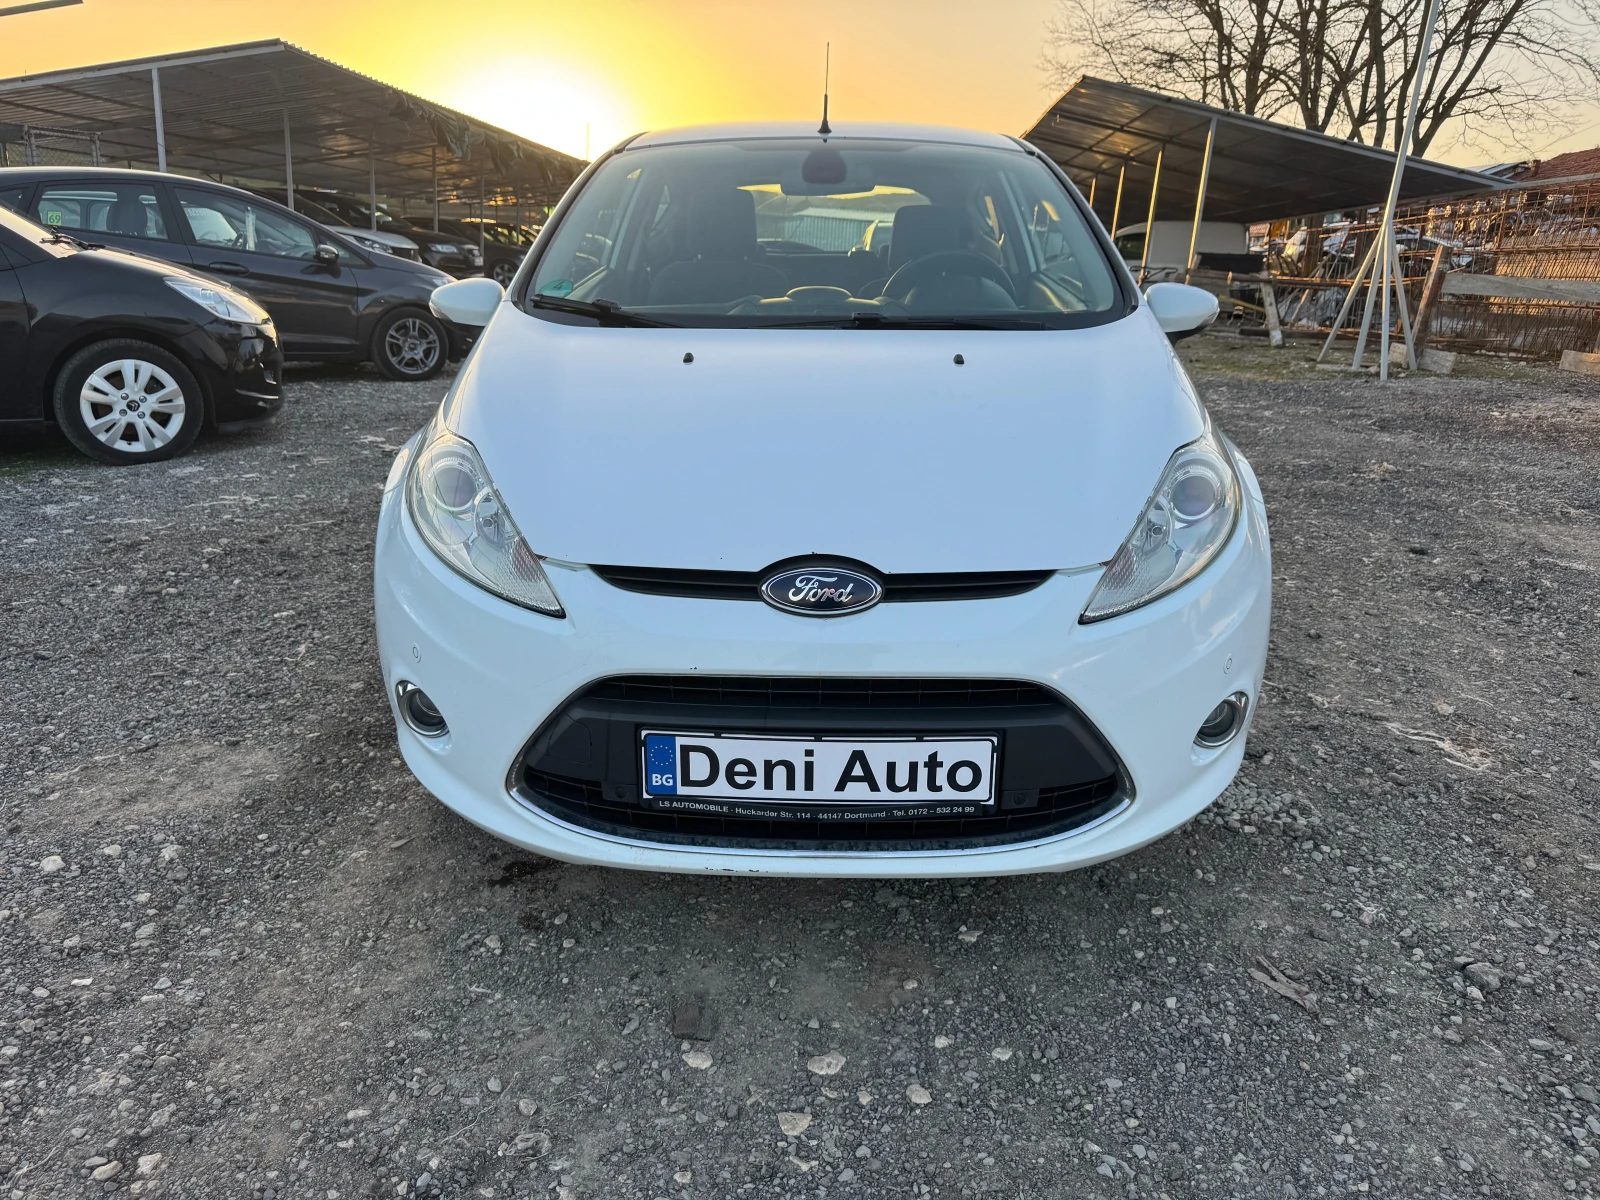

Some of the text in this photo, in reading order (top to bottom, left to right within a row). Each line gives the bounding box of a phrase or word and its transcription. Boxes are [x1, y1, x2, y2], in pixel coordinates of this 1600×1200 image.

[48, 214, 61, 224] 69
[553, 280, 565, 290] 4
[788, 575, 854, 602] Ford
[680, 744, 983, 793] Deni Auto
[652, 774, 674, 786] BG
[672, 801, 729, 812] AUTOMOBILE
[735, 807, 778, 817] Huckarder
[780, 811, 794, 819] Str.
[817, 812, 842, 820] 44147
[844, 811, 886, 819] Dortmund
[908, 808, 928, 816] 0172
